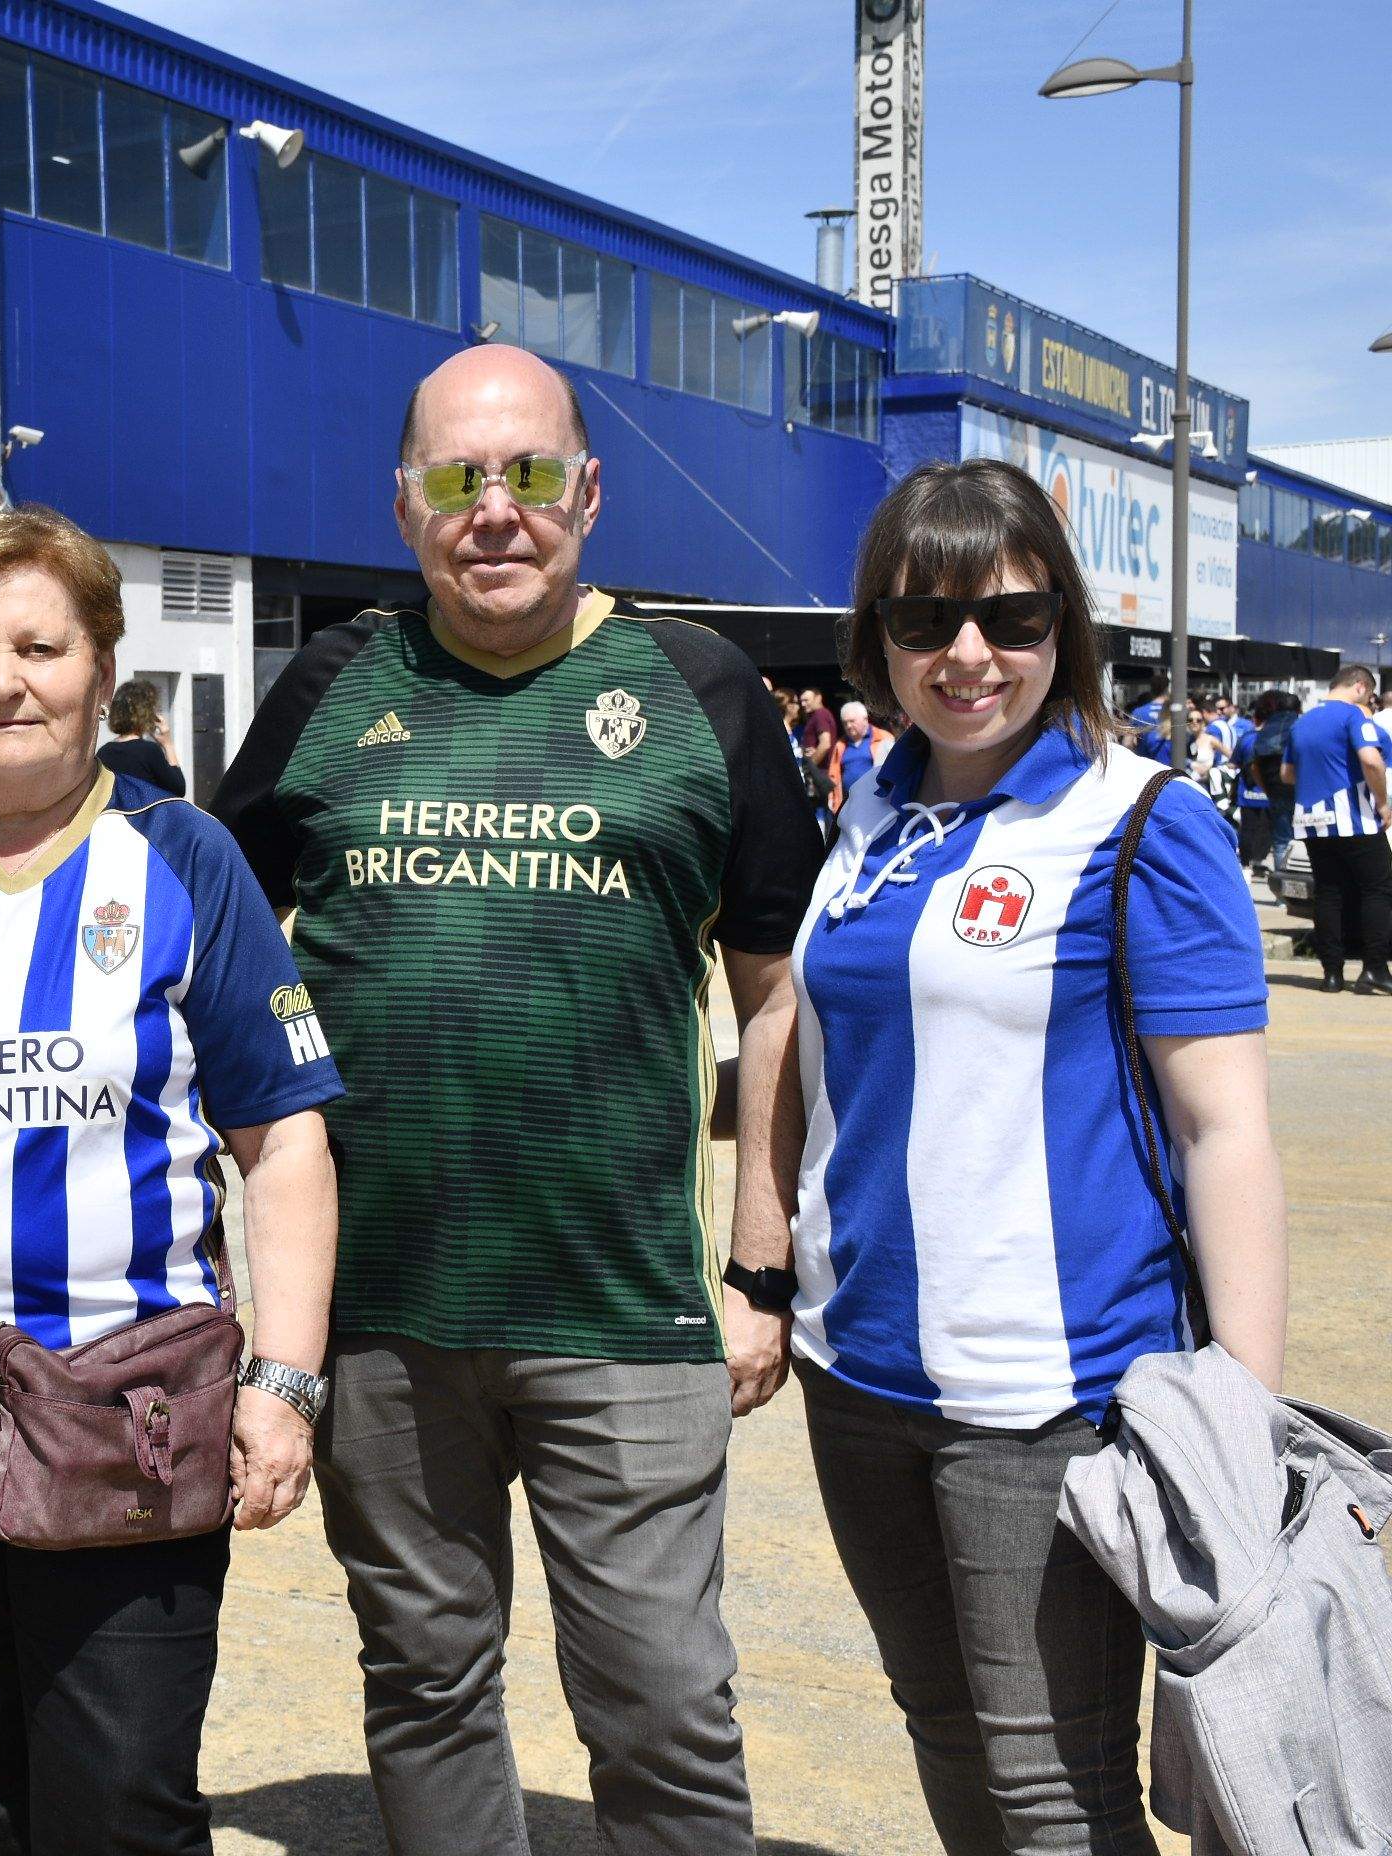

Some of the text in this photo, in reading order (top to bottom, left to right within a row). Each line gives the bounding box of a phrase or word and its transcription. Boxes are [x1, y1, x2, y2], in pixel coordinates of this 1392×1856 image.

[862, 36, 893, 161] Motor
[1141, 375, 1157, 432] EL
[357, 730, 411, 747] adidas
[379, 800, 601, 842] HERRERO
[345, 847, 631, 899] BRIGANTINA
